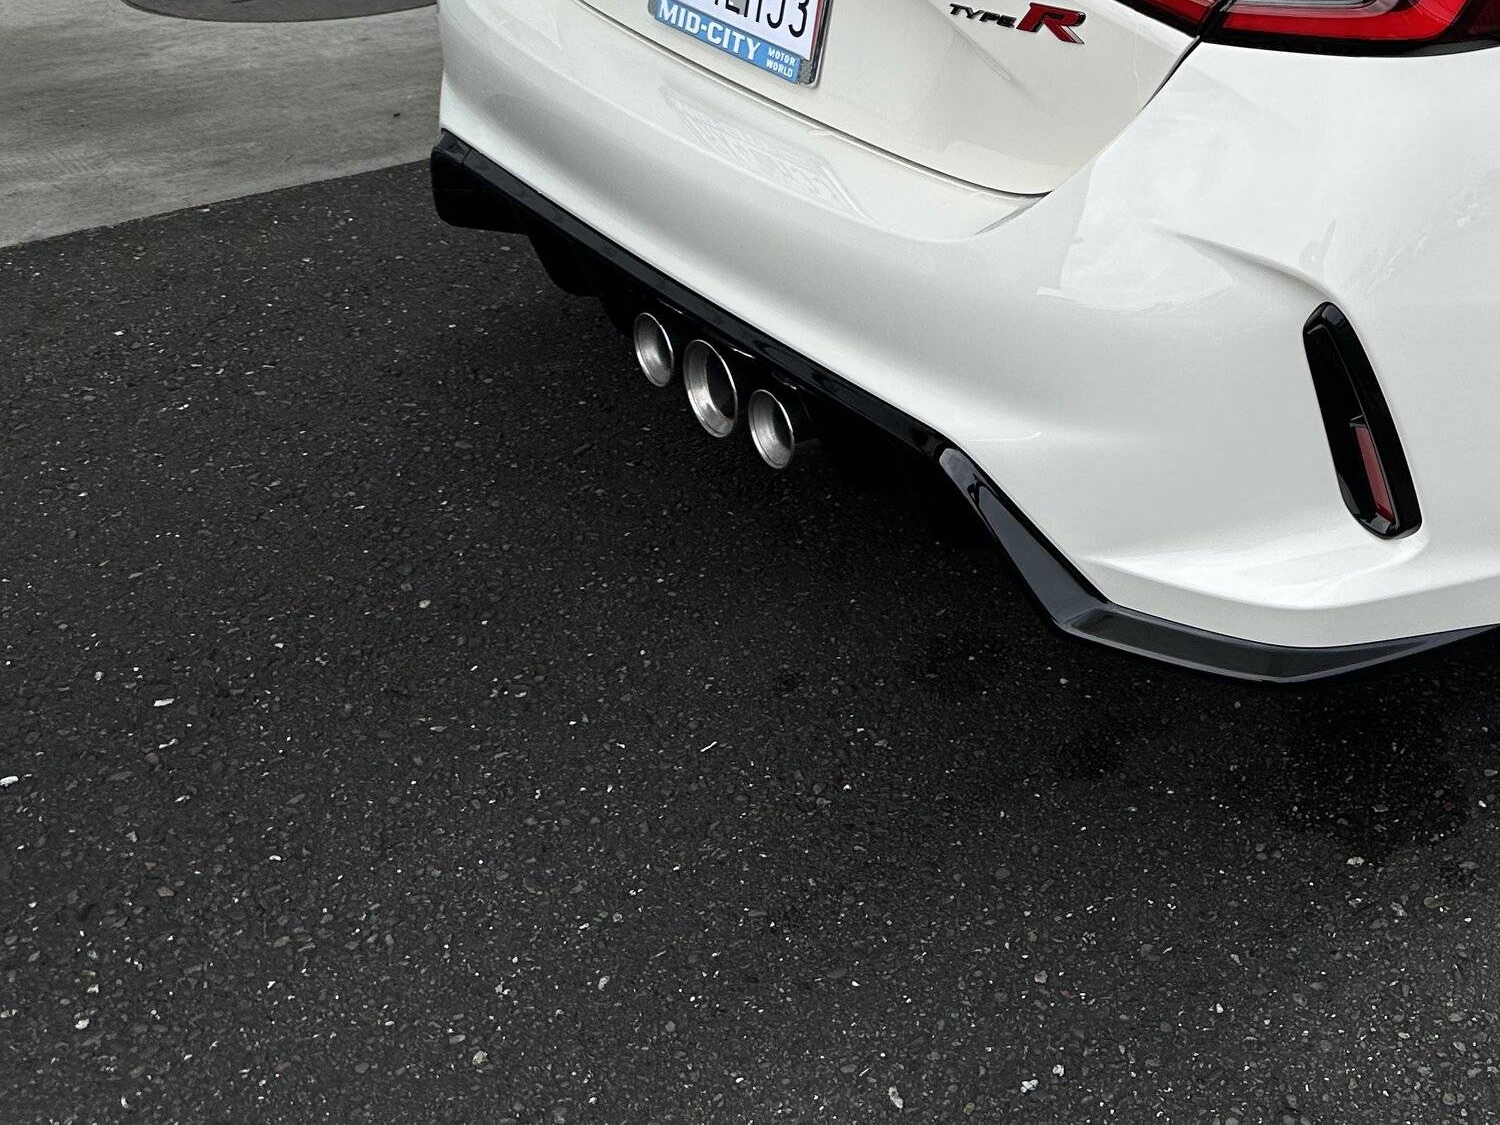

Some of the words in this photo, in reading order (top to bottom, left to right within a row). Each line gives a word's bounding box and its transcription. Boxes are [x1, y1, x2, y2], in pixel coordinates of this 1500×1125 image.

[949, 2, 1017, 29] TYPE
[1015, 2, 1086, 45] R
[767, 47, 796, 66] MOTOR
[766, 59, 794, 78] WORLD
